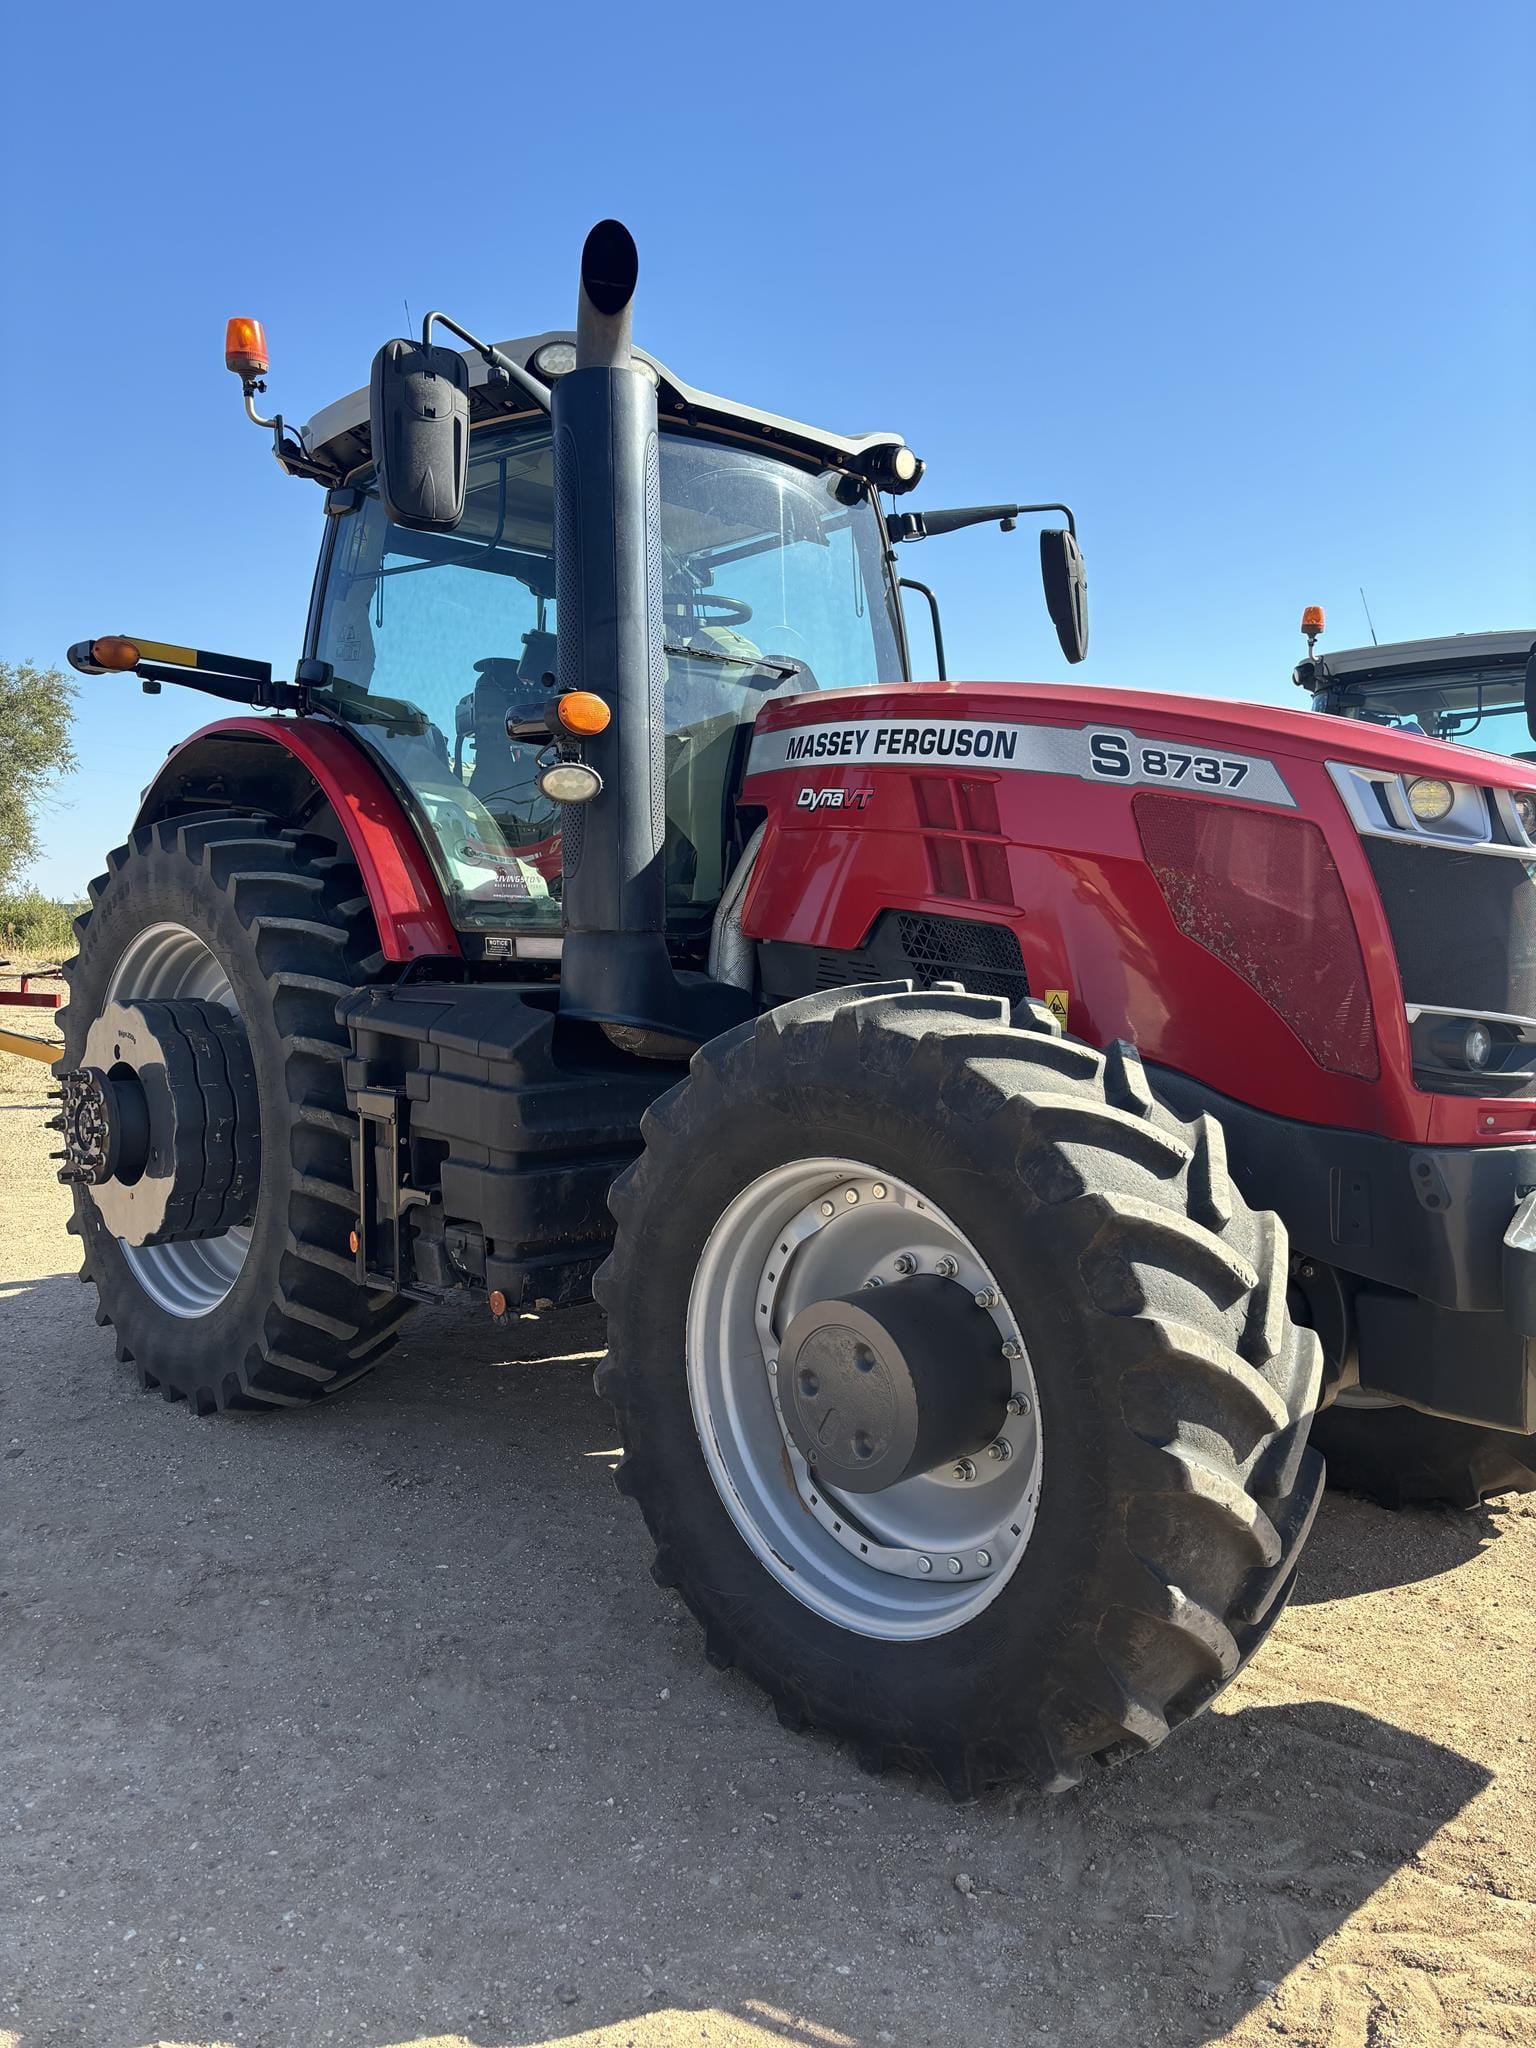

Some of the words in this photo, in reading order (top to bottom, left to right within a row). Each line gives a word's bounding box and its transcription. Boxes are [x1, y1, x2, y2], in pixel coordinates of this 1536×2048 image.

[785, 729, 870, 761] MASSEY
[873, 727, 1019, 760] FERGUSON
[1089, 733, 1132, 779] S
[1140, 748, 1250, 789] 8737
[797, 788, 875, 811] DynaVT
